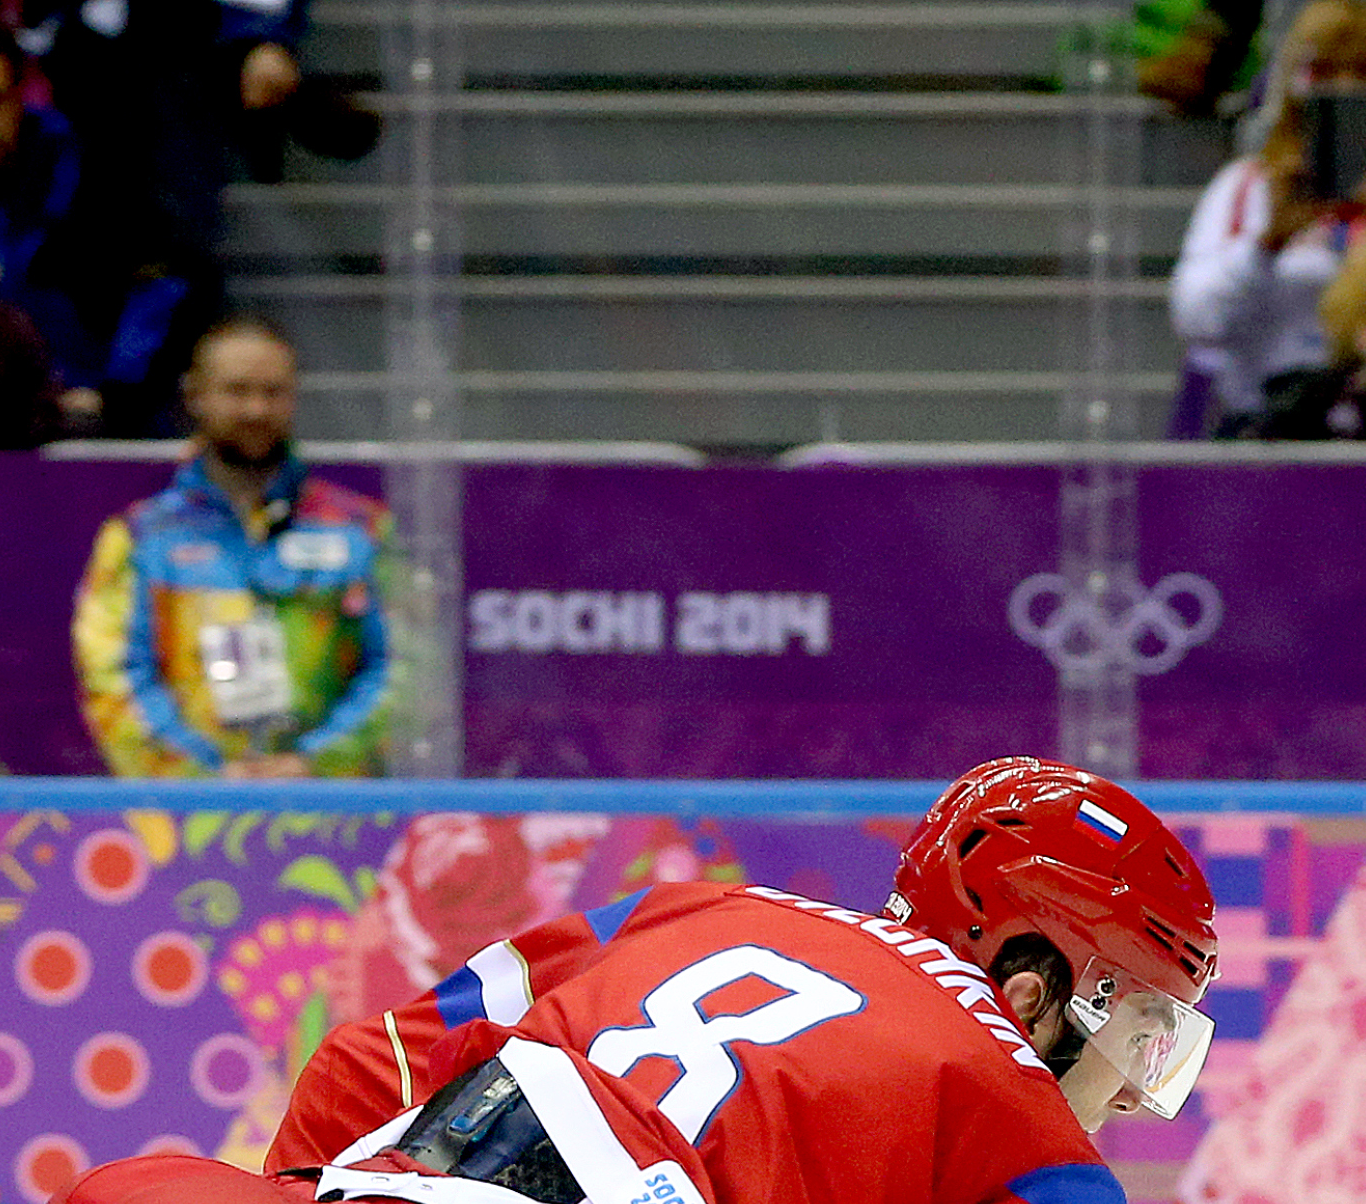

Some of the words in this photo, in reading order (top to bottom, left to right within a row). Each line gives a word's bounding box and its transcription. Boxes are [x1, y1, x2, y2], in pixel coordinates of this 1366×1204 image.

[468, 587, 664, 654] SOCHI
[675, 588, 832, 656] 2014
[586, 943, 868, 1148] 8
